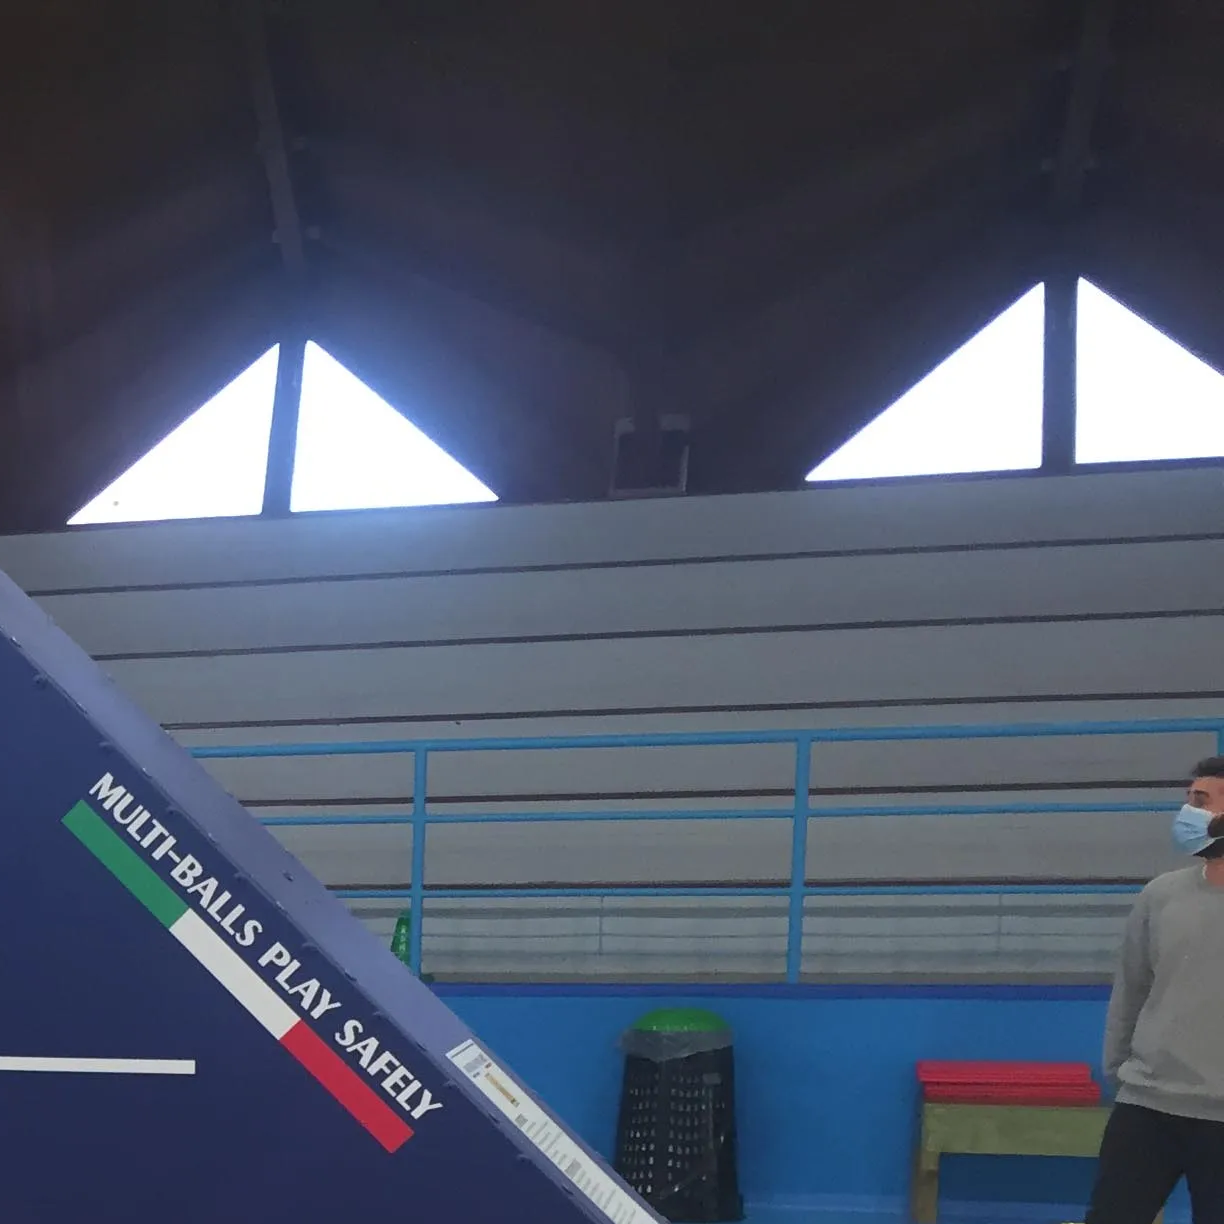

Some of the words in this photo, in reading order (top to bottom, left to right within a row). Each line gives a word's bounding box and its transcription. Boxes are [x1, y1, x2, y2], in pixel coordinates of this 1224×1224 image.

[88, 772, 263, 947] MULTI-BALLS
[257, 942, 342, 1020] PLAY
[334, 1019, 444, 1120] SAFELY
